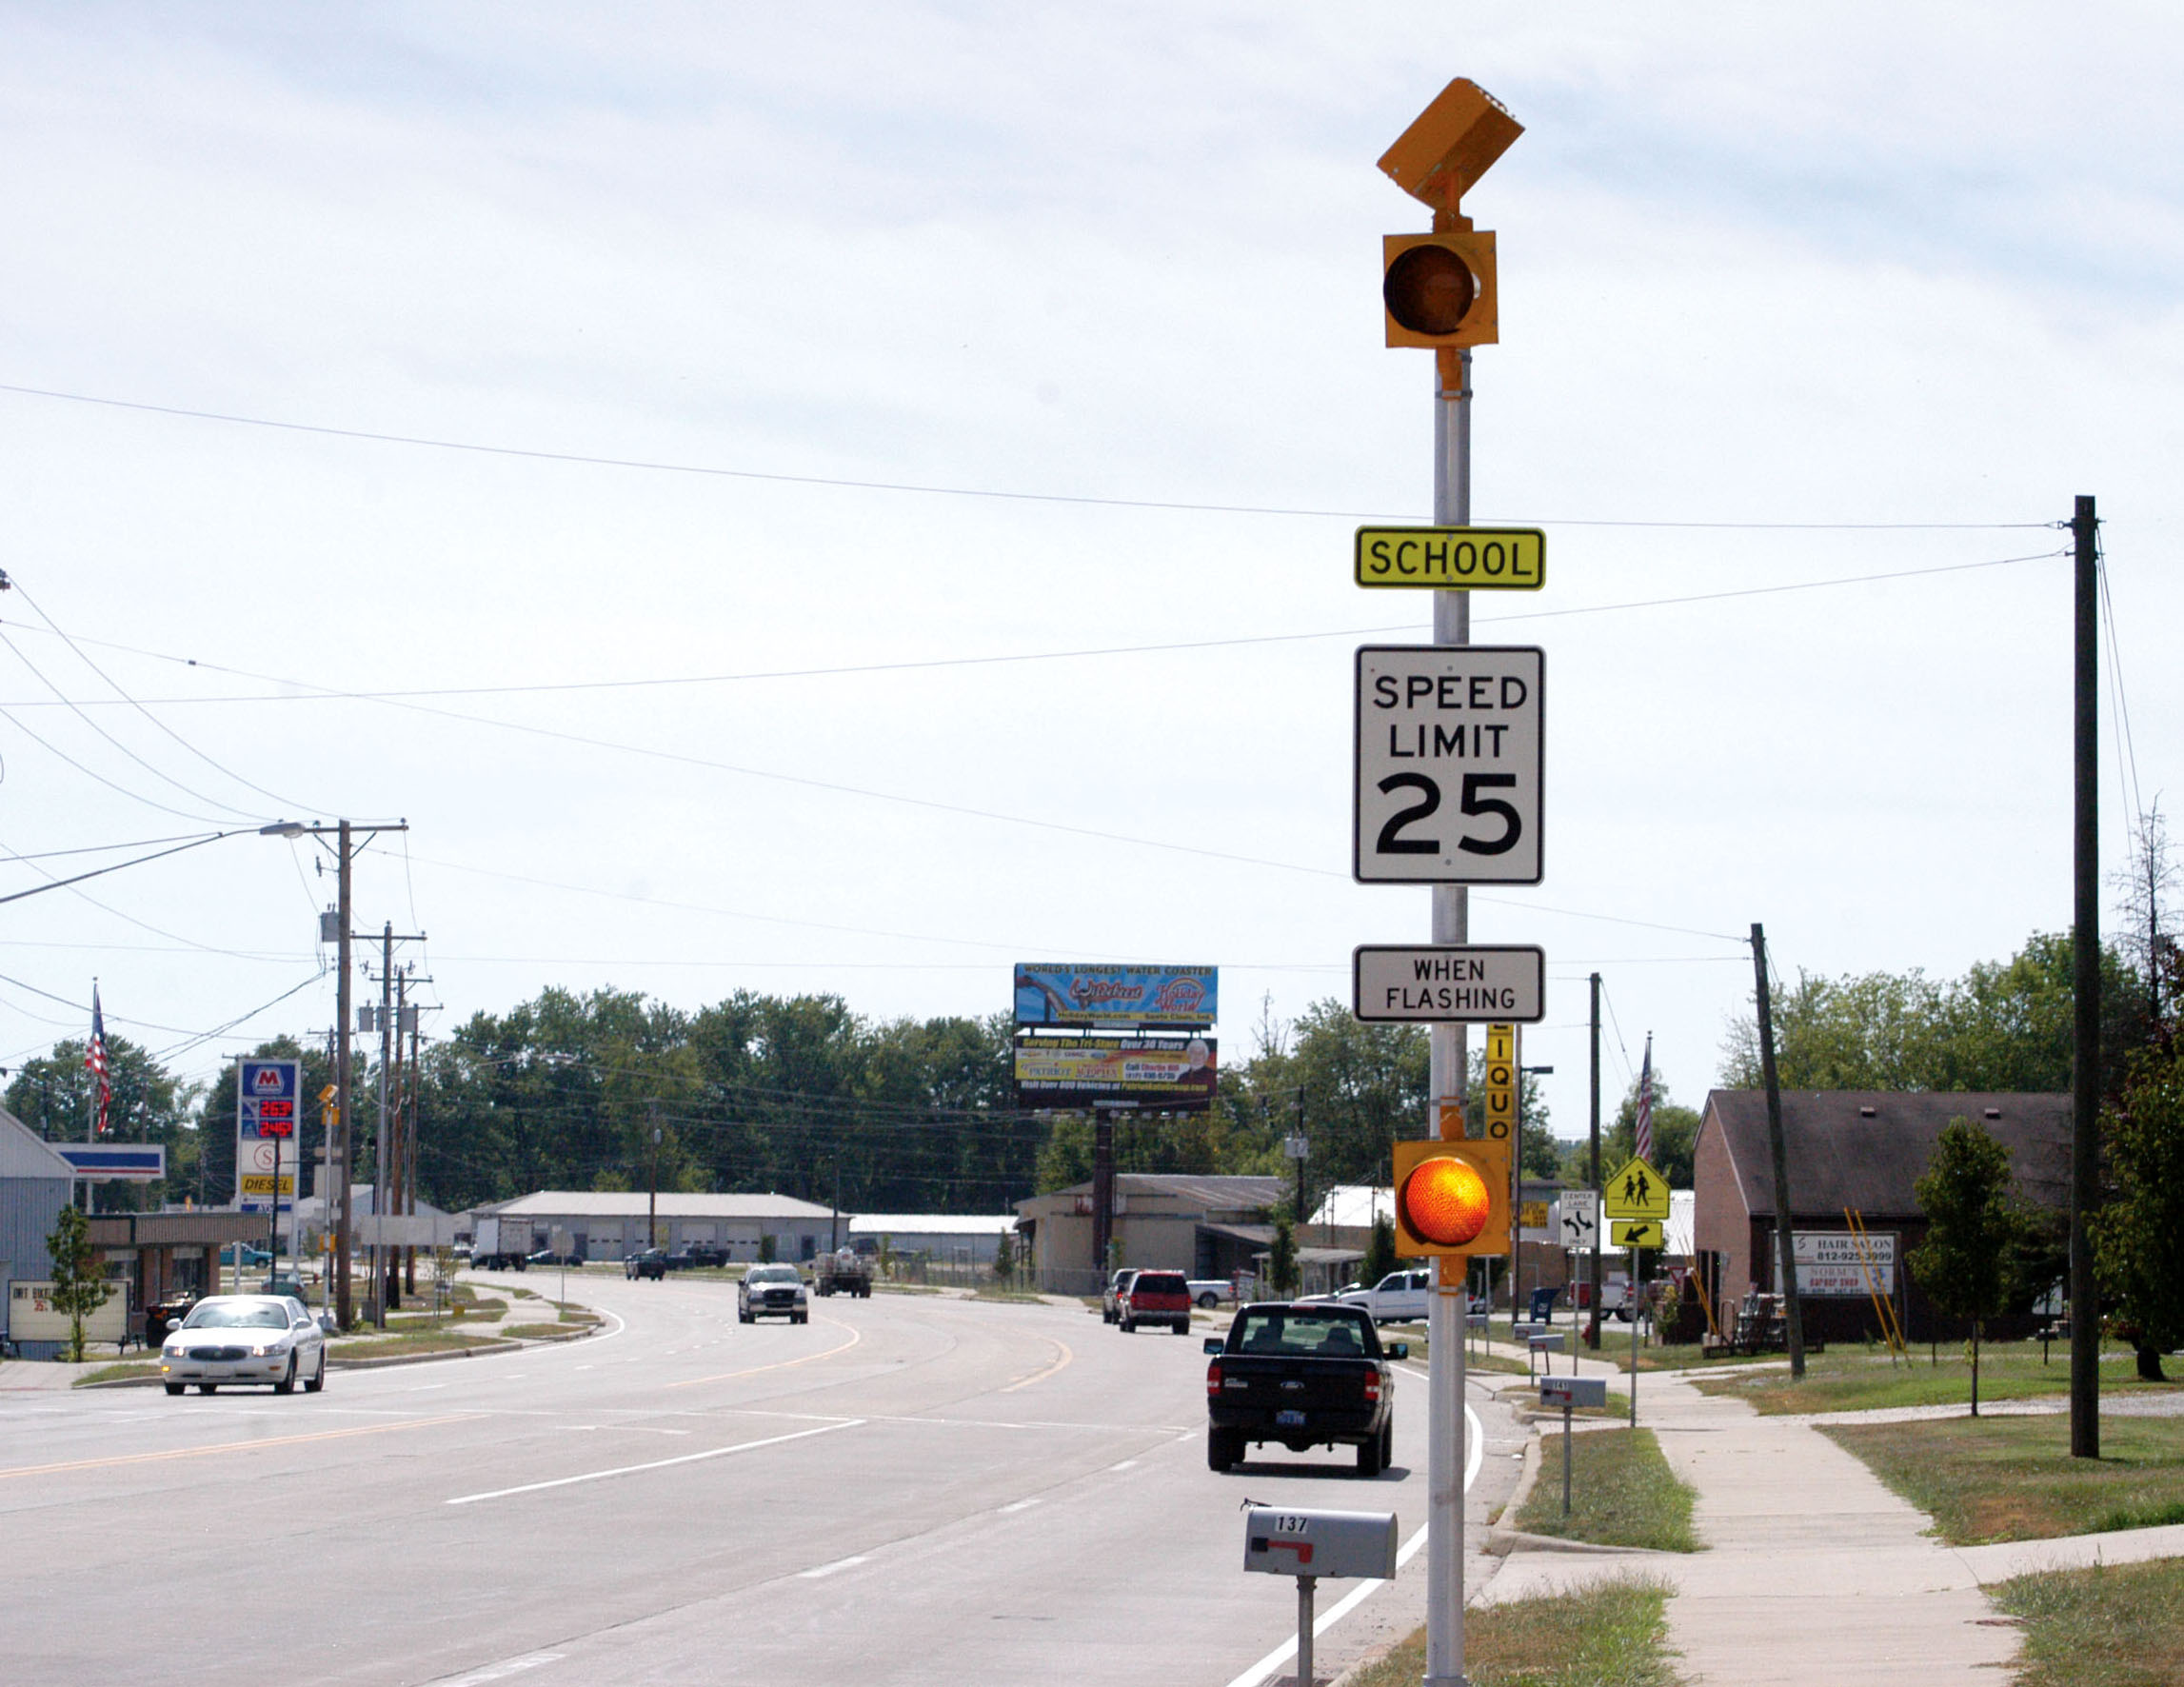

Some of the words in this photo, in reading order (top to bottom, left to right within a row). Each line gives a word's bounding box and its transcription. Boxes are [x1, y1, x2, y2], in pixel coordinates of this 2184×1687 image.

[1369, 542, 1533, 575] SCHOOL
[1373, 676, 1528, 709] SPEED
[1390, 724, 1510, 758] LIMIT
[1377, 772, 1523, 856] 25
[1024, 964, 1070, 973] WORLD'S
[1074, 965, 1122, 975] LONGEST
[1126, 965, 1161, 975] WATER
[1164, 966, 1212, 976] COASTER
[1415, 960, 1485, 982] WHEN
[1386, 988, 1516, 1009] FLASHING
[1121, 1039, 1142, 1050] Over
[1157, 1041, 1185, 1050] Years
[1488, 1023, 1510, 1140] IQUO
[263, 1149, 273, 1165] S
[244, 1179, 289, 1191] DIESEL
[1817, 1240, 1848, 1249] HAIR
[1817, 1251, 1892, 1260] 812-9253999
[1278, 1516, 1308, 1532] 137
